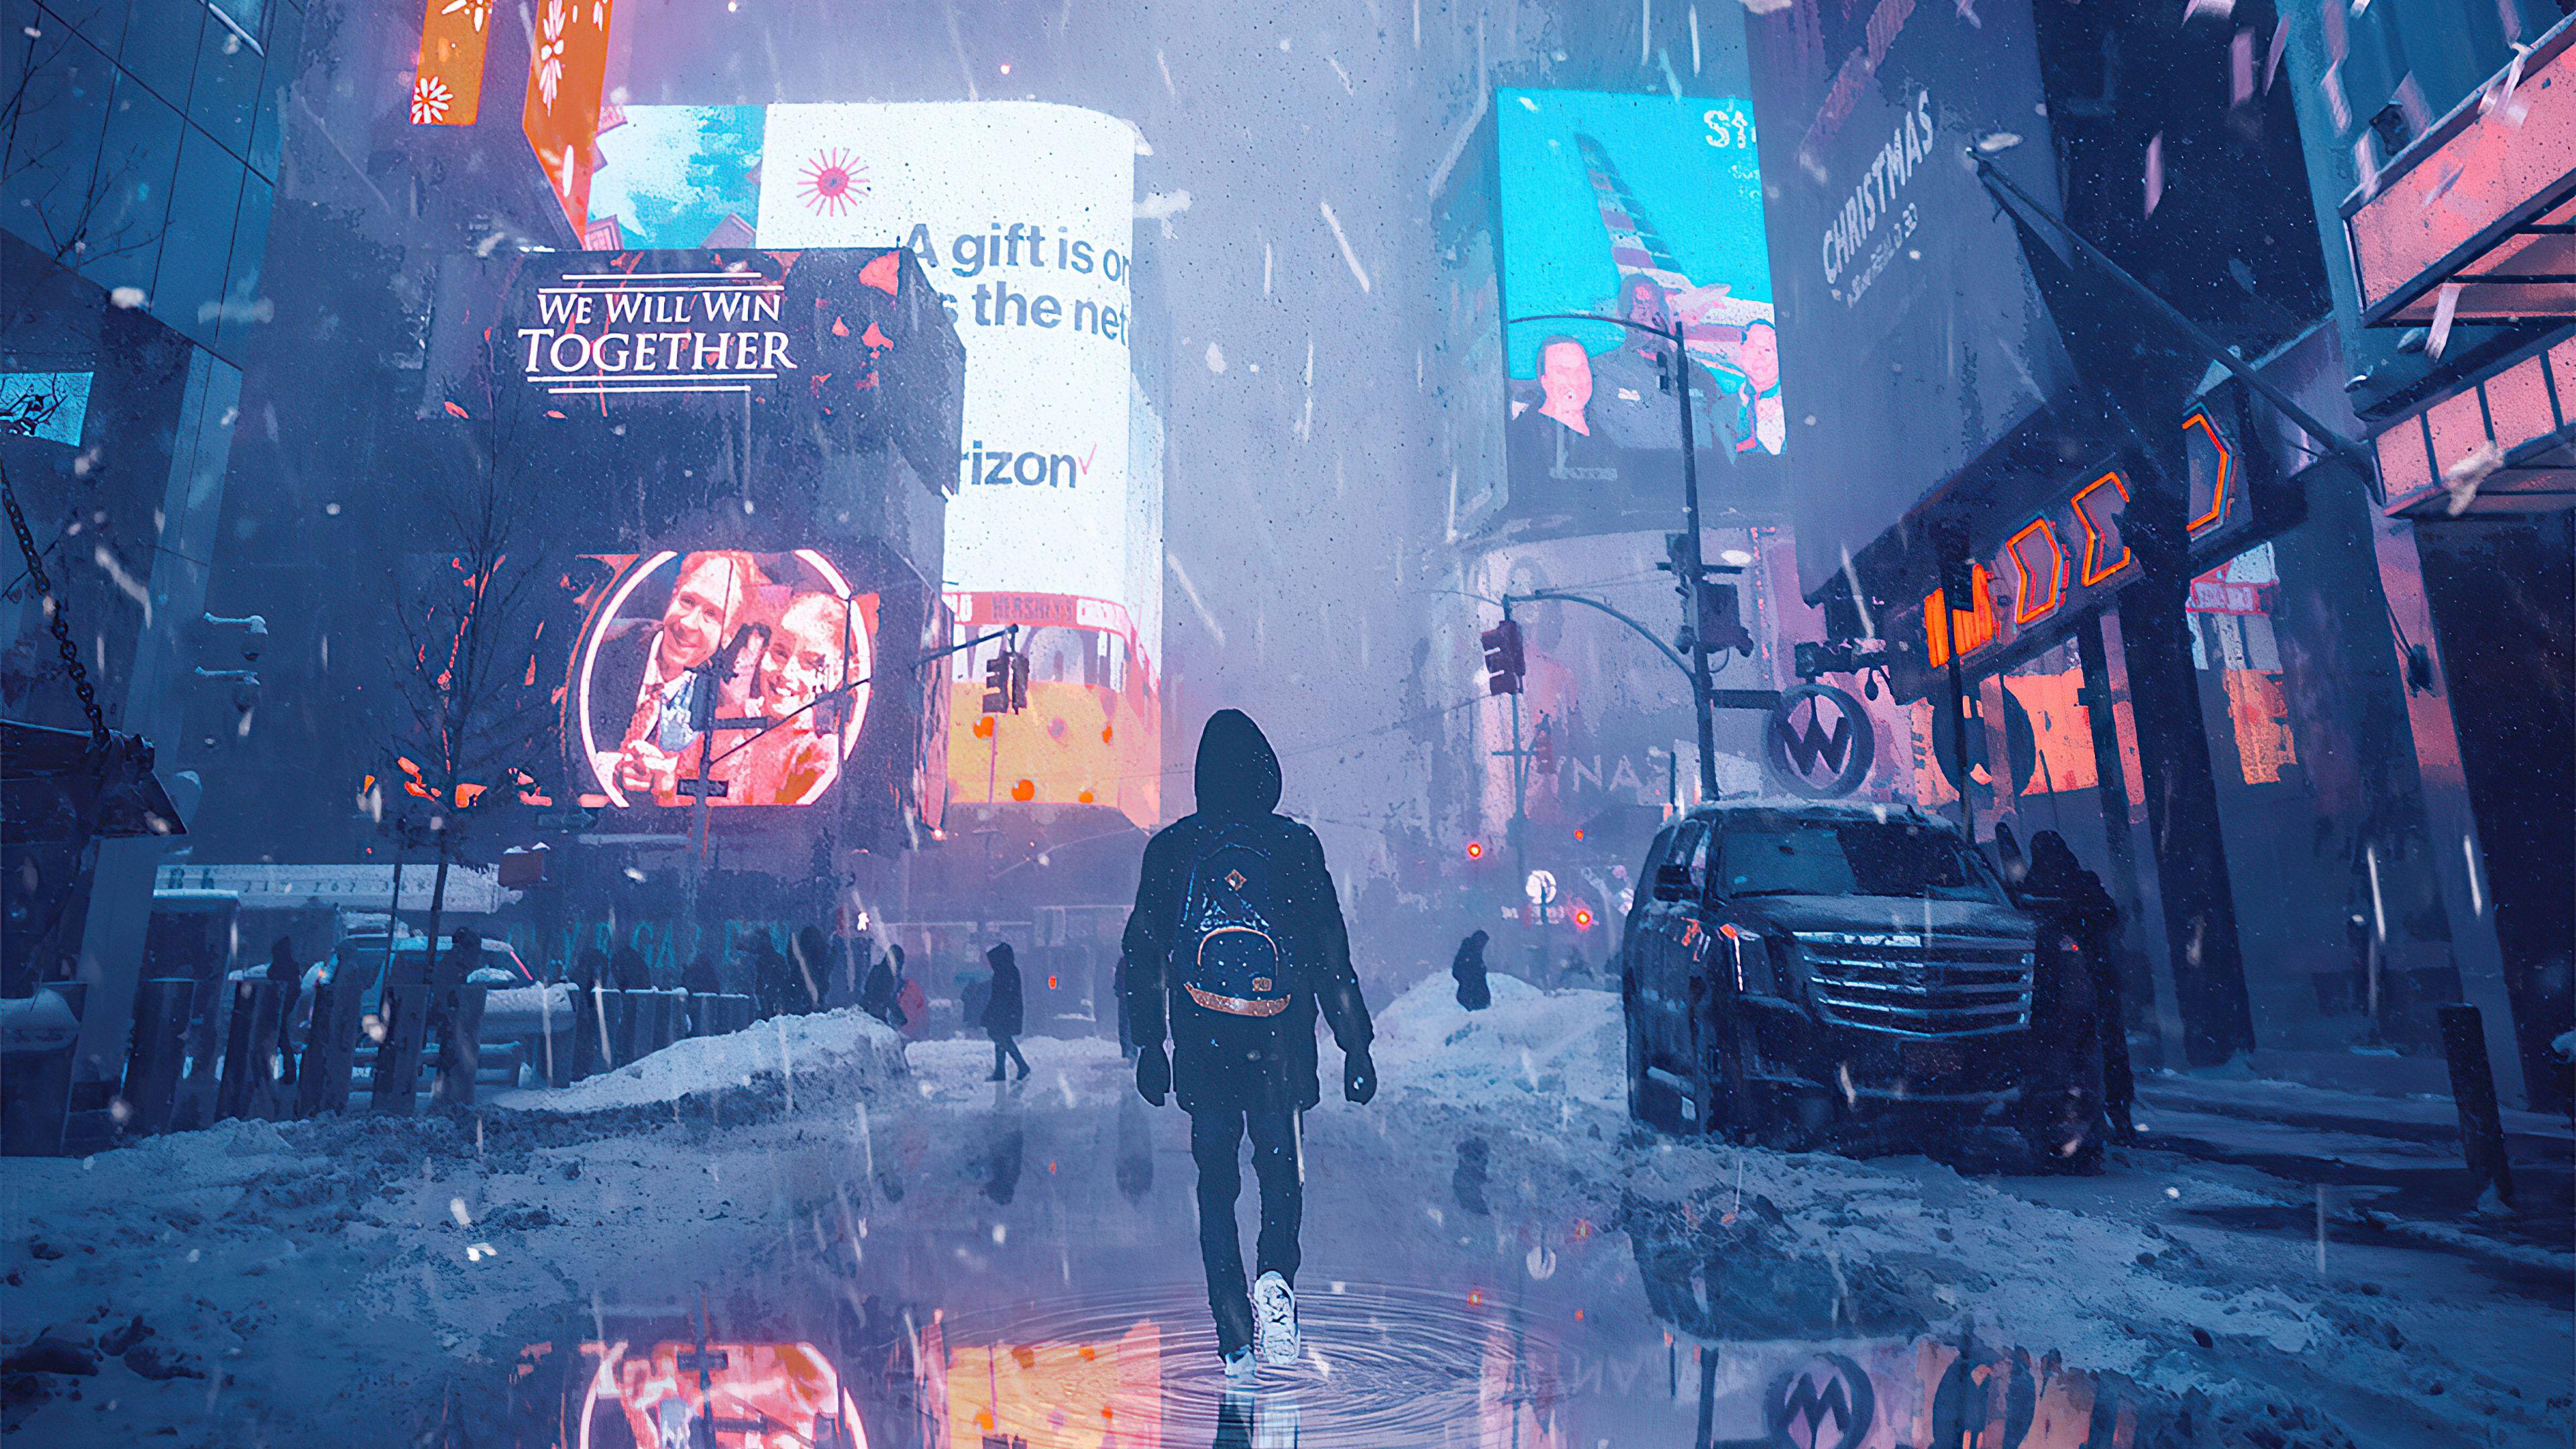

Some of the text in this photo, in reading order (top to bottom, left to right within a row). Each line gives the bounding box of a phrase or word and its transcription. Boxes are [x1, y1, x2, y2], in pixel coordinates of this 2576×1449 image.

[1823, 89, 1933, 284] CHRISTMAS
[907, 223, 938, 268] A
[951, 223, 1045, 278] gift
[1058, 225, 1095, 274] is
[971, 281, 1063, 328] the
[517, 328, 798, 373] TOGETHER
